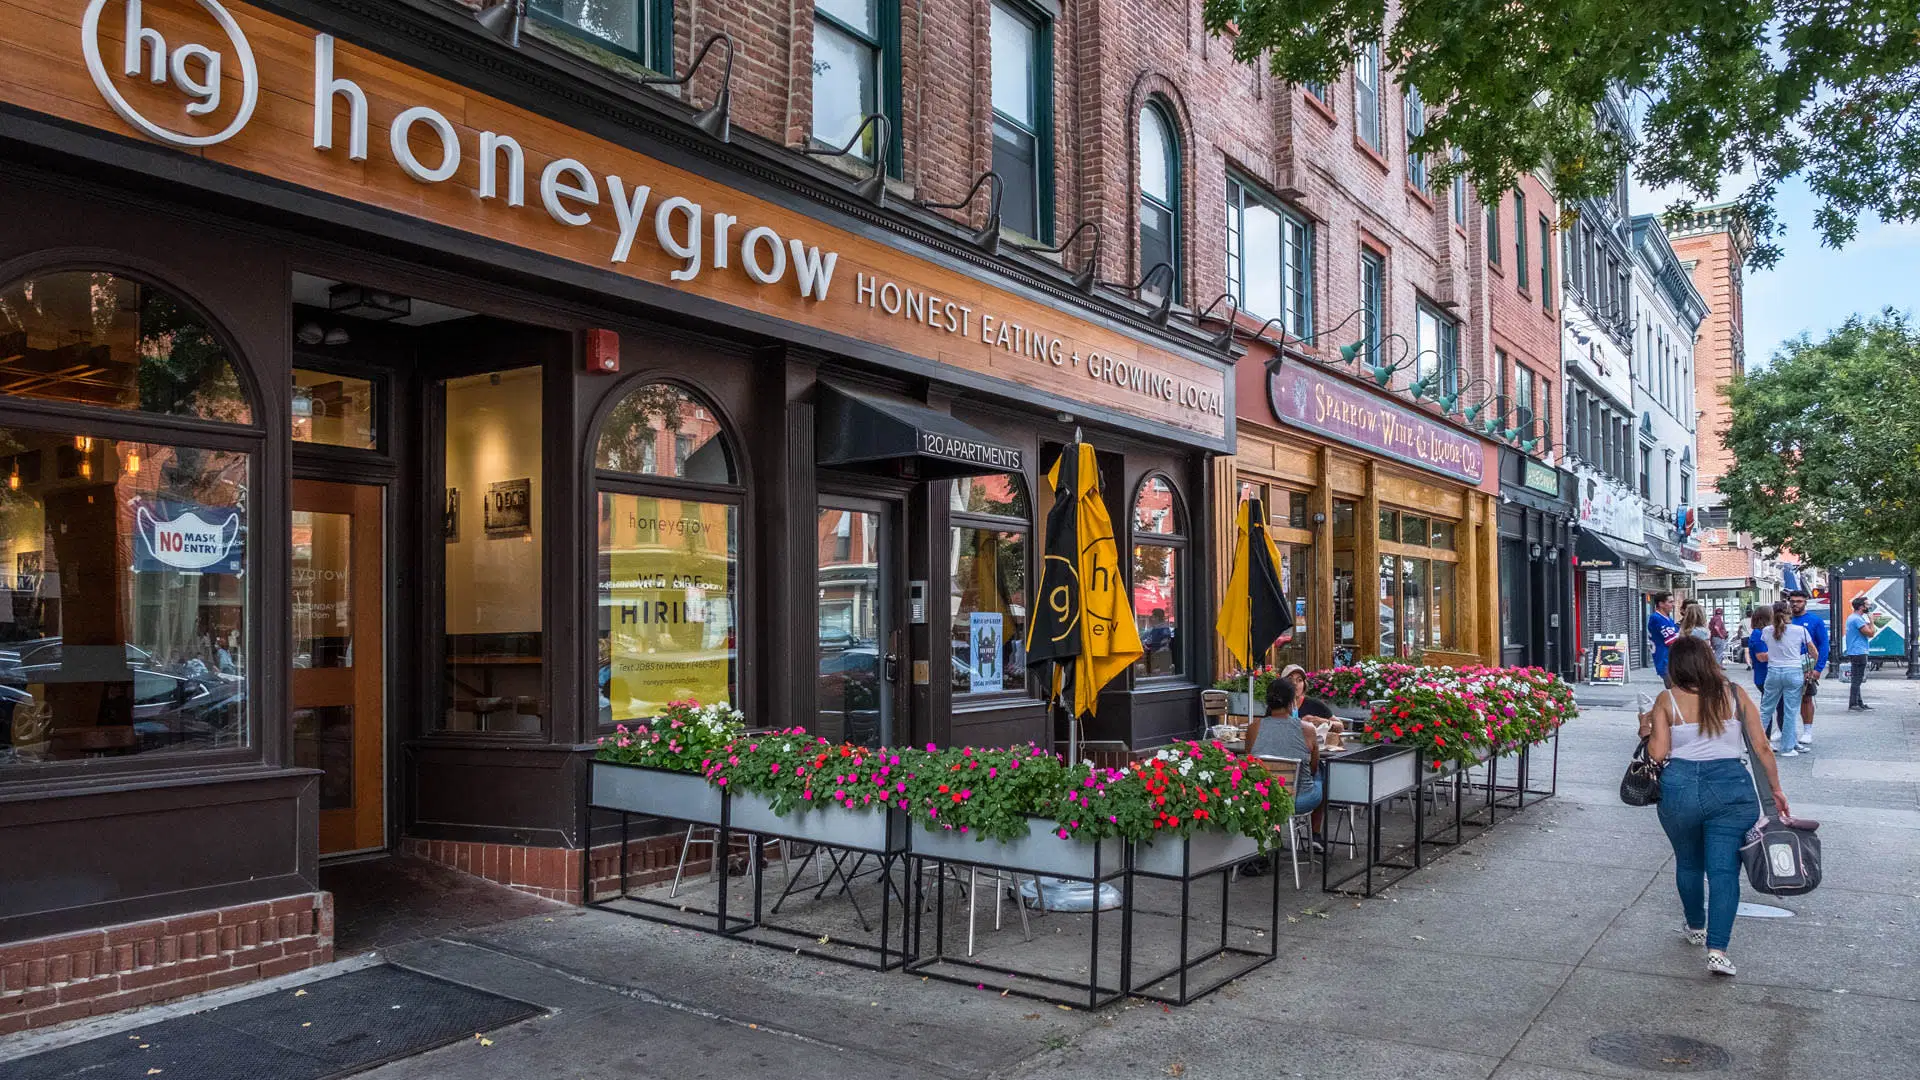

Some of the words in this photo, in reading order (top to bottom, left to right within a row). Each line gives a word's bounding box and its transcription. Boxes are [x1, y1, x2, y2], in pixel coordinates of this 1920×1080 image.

[123, 0, 222, 116] hg
[313, 32, 838, 302] honeygrow
[856, 272, 972, 337] HONEST
[981, 314, 1064, 367] EATING
[1070, 354, 1081, 367] +
[1088, 351, 1173, 402] GROWING
[1179, 377, 1225, 418] LOCAL
[922, 432, 945, 455] 120
[945, 439, 1021, 469] APARTMENTS
[1416, 425, 1428, 459] &
[184, 532, 217, 543] MASK
[628, 512, 712, 537] honeygrow
[160, 531, 184, 553] NO
[184, 544, 218, 554] ENTRY
[638, 572, 666, 589] WE
